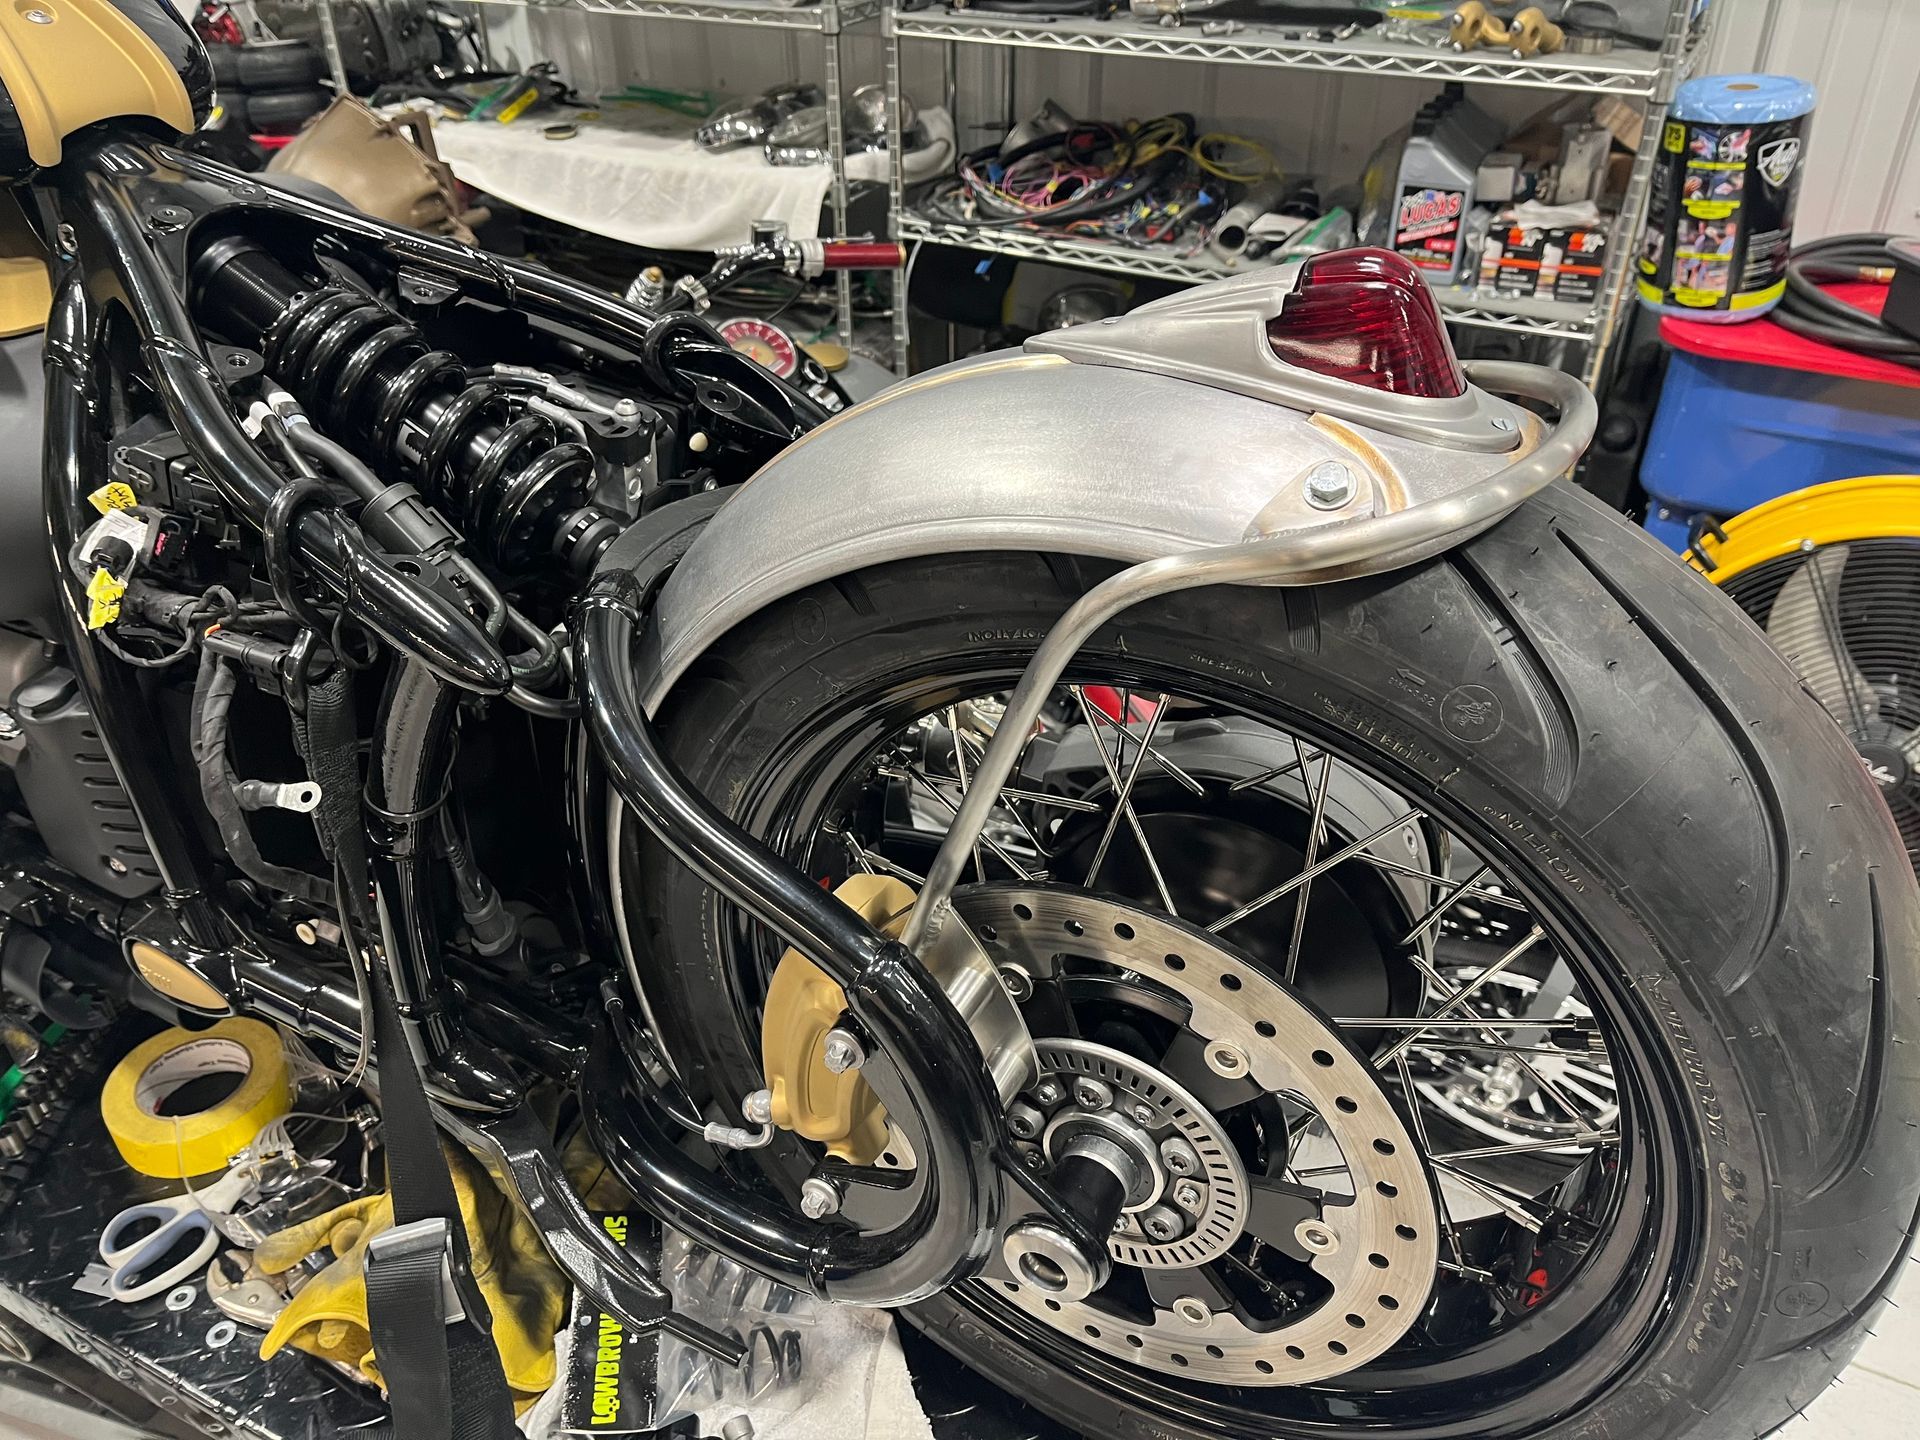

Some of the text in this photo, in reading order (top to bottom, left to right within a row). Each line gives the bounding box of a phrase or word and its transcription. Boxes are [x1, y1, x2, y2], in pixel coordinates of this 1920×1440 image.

[1400, 195, 1461, 228] LUCAS
[1321, 704, 1419, 763] TUBELESS
[1500, 811, 1591, 894] MICHELIN
[591, 1312, 623, 1425] LOWBROW
